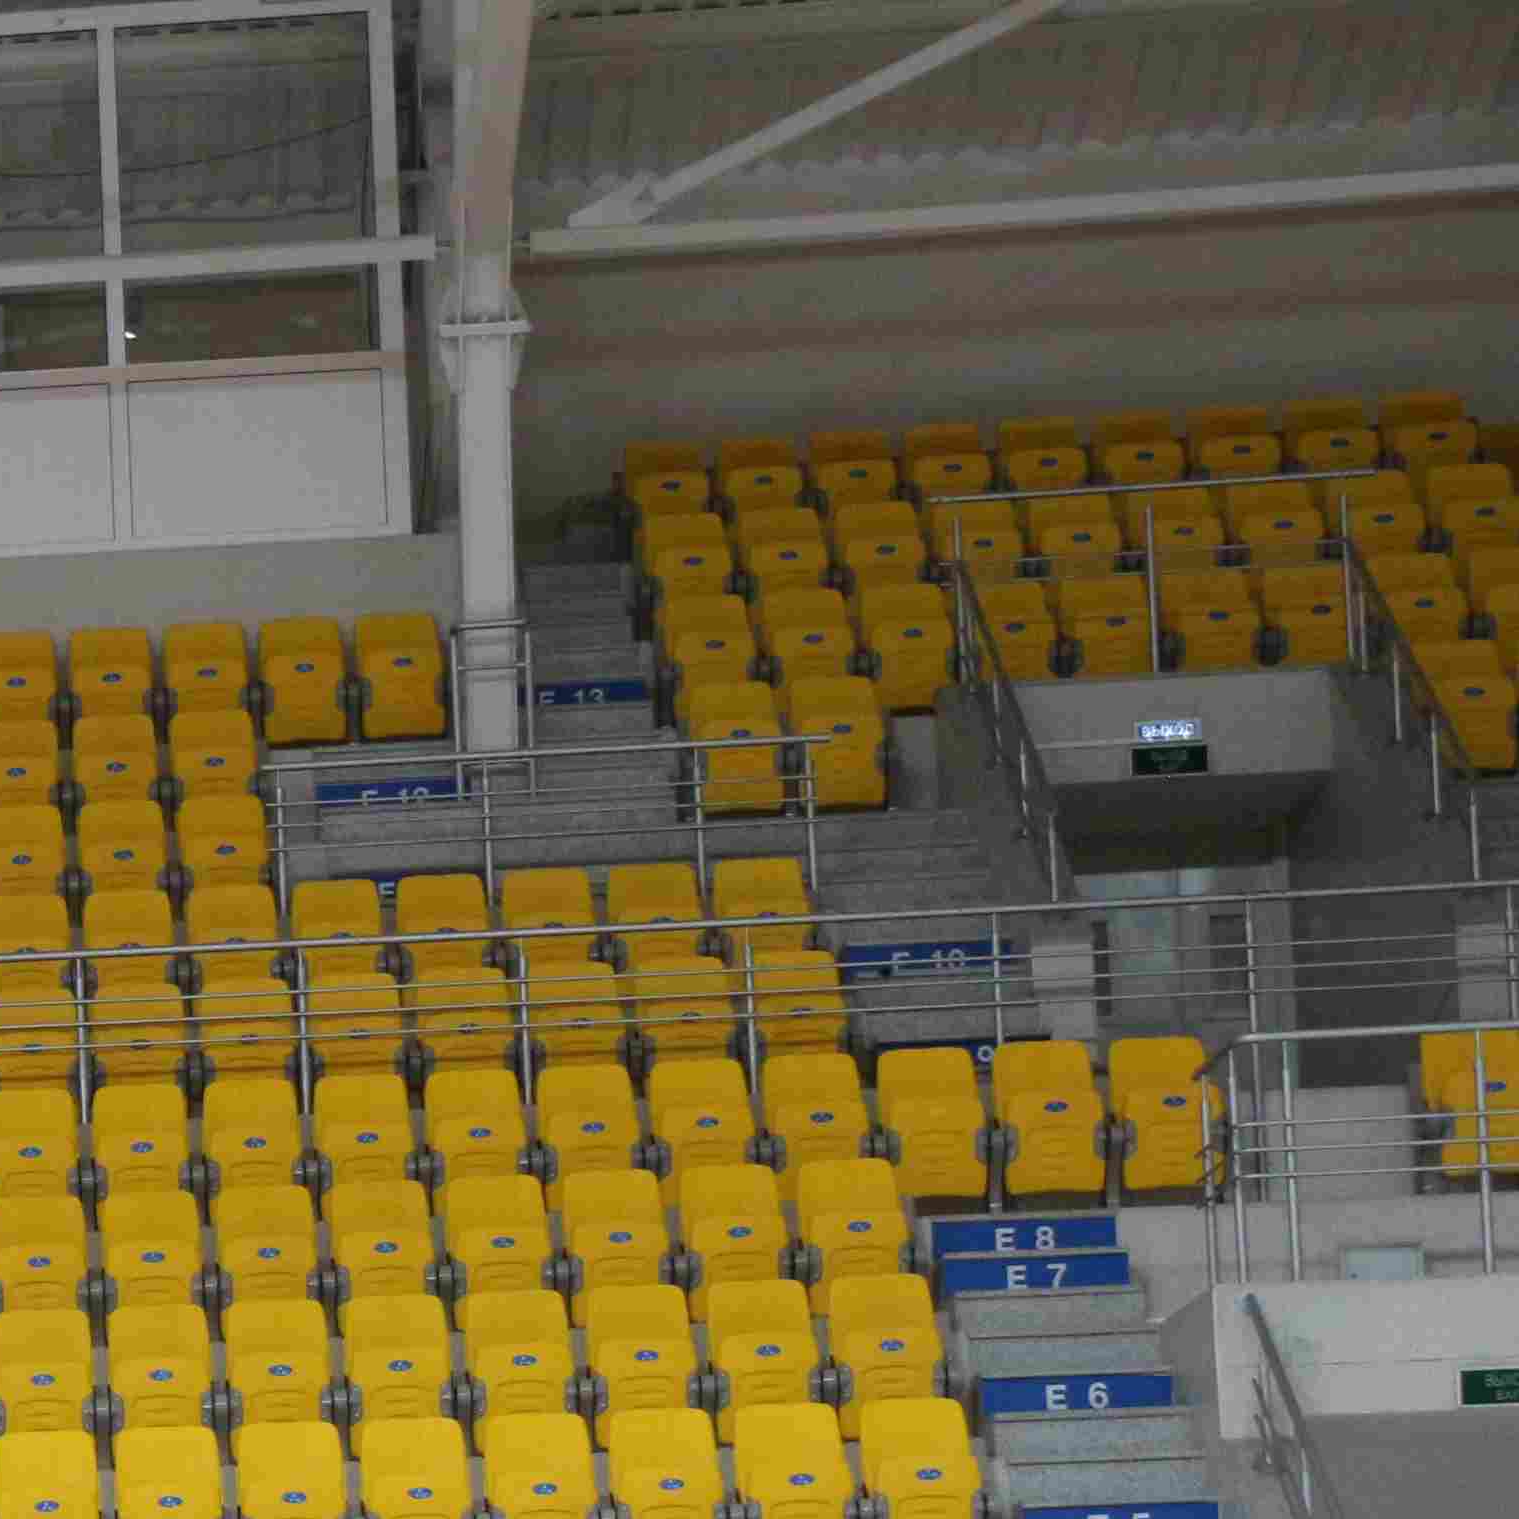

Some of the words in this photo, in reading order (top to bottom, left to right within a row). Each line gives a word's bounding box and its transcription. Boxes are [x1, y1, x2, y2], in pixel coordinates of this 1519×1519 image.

[995, 1227, 1016, 1250] E
[1035, 1225, 1055, 1250] 8
[1006, 1265, 1026, 1289] E
[1047, 1263, 1067, 1288] 7
[1045, 1384, 1067, 1410] E
[1087, 1382, 1109, 1408] 6
